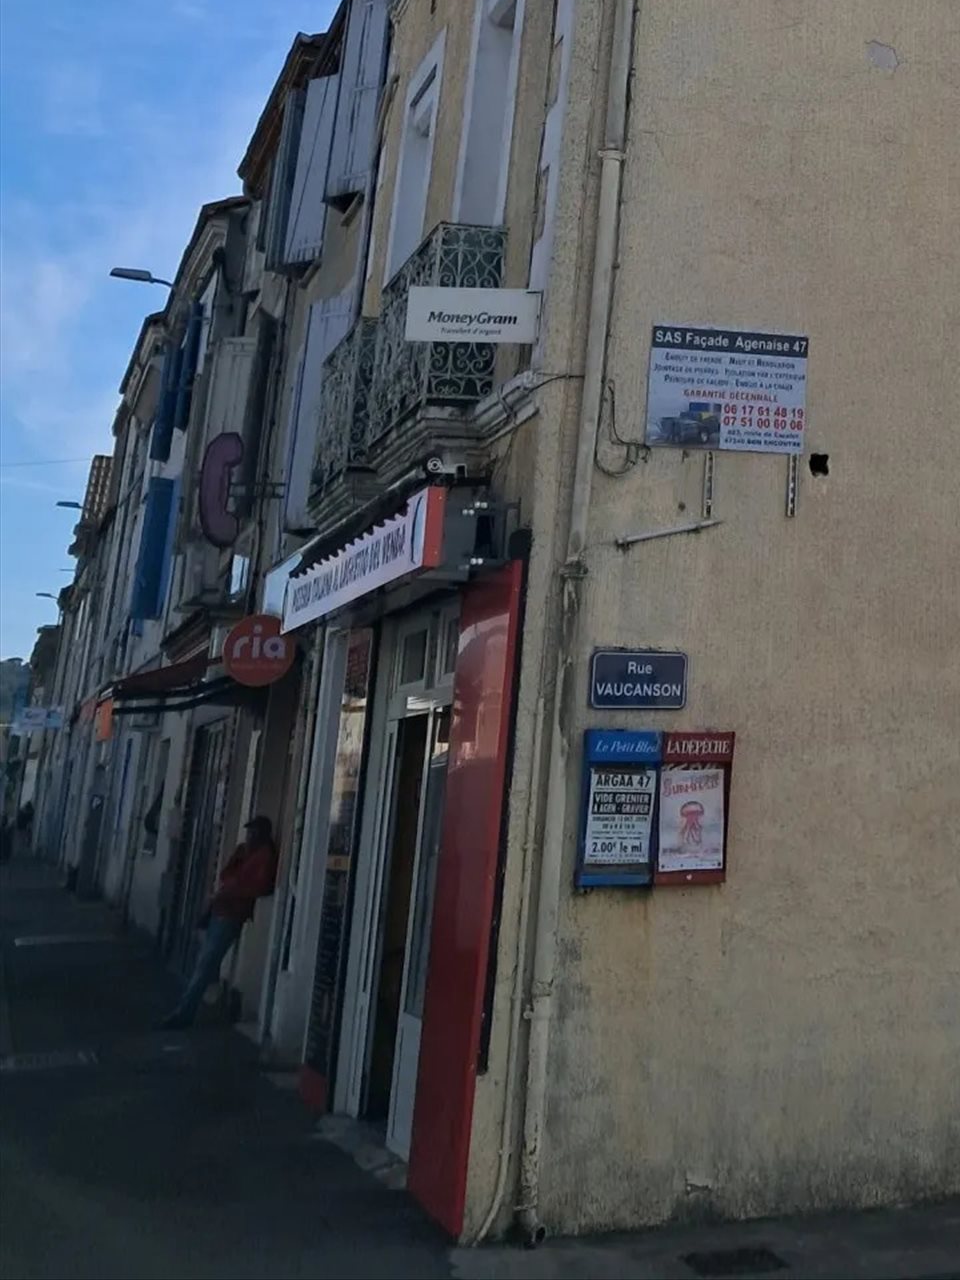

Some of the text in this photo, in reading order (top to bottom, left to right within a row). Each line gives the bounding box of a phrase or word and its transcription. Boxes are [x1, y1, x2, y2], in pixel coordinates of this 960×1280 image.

[428, 311, 518, 326] MoneyGram
[655, 330, 807, 353] SAS Façade Agenaise 47
[683, 389, 726, 400] GARANTIE
[723, 404, 737, 415] 06
[742, 405, 754, 415] 17
[758, 406, 770, 417] 61
[792, 408, 804, 419] 19
[723, 416, 737, 426] 07
[741, 417, 753, 427] 51
[757, 418, 770, 429] 00
[790, 420, 803, 431] 06
[233, 624, 286, 659] ria
[627, 661, 653, 675] Rue
[596, 683, 681, 697] VAUCANSON
[595, 740, 608, 753] Le
[610, 740, 634, 753] Petit
[596, 774, 633, 787] ARGAA
[637, 776, 652, 788] 47
[595, 793, 650, 804] VIDE GRENIER
[619, 841, 628, 853] le
[631, 841, 642, 853] ml
